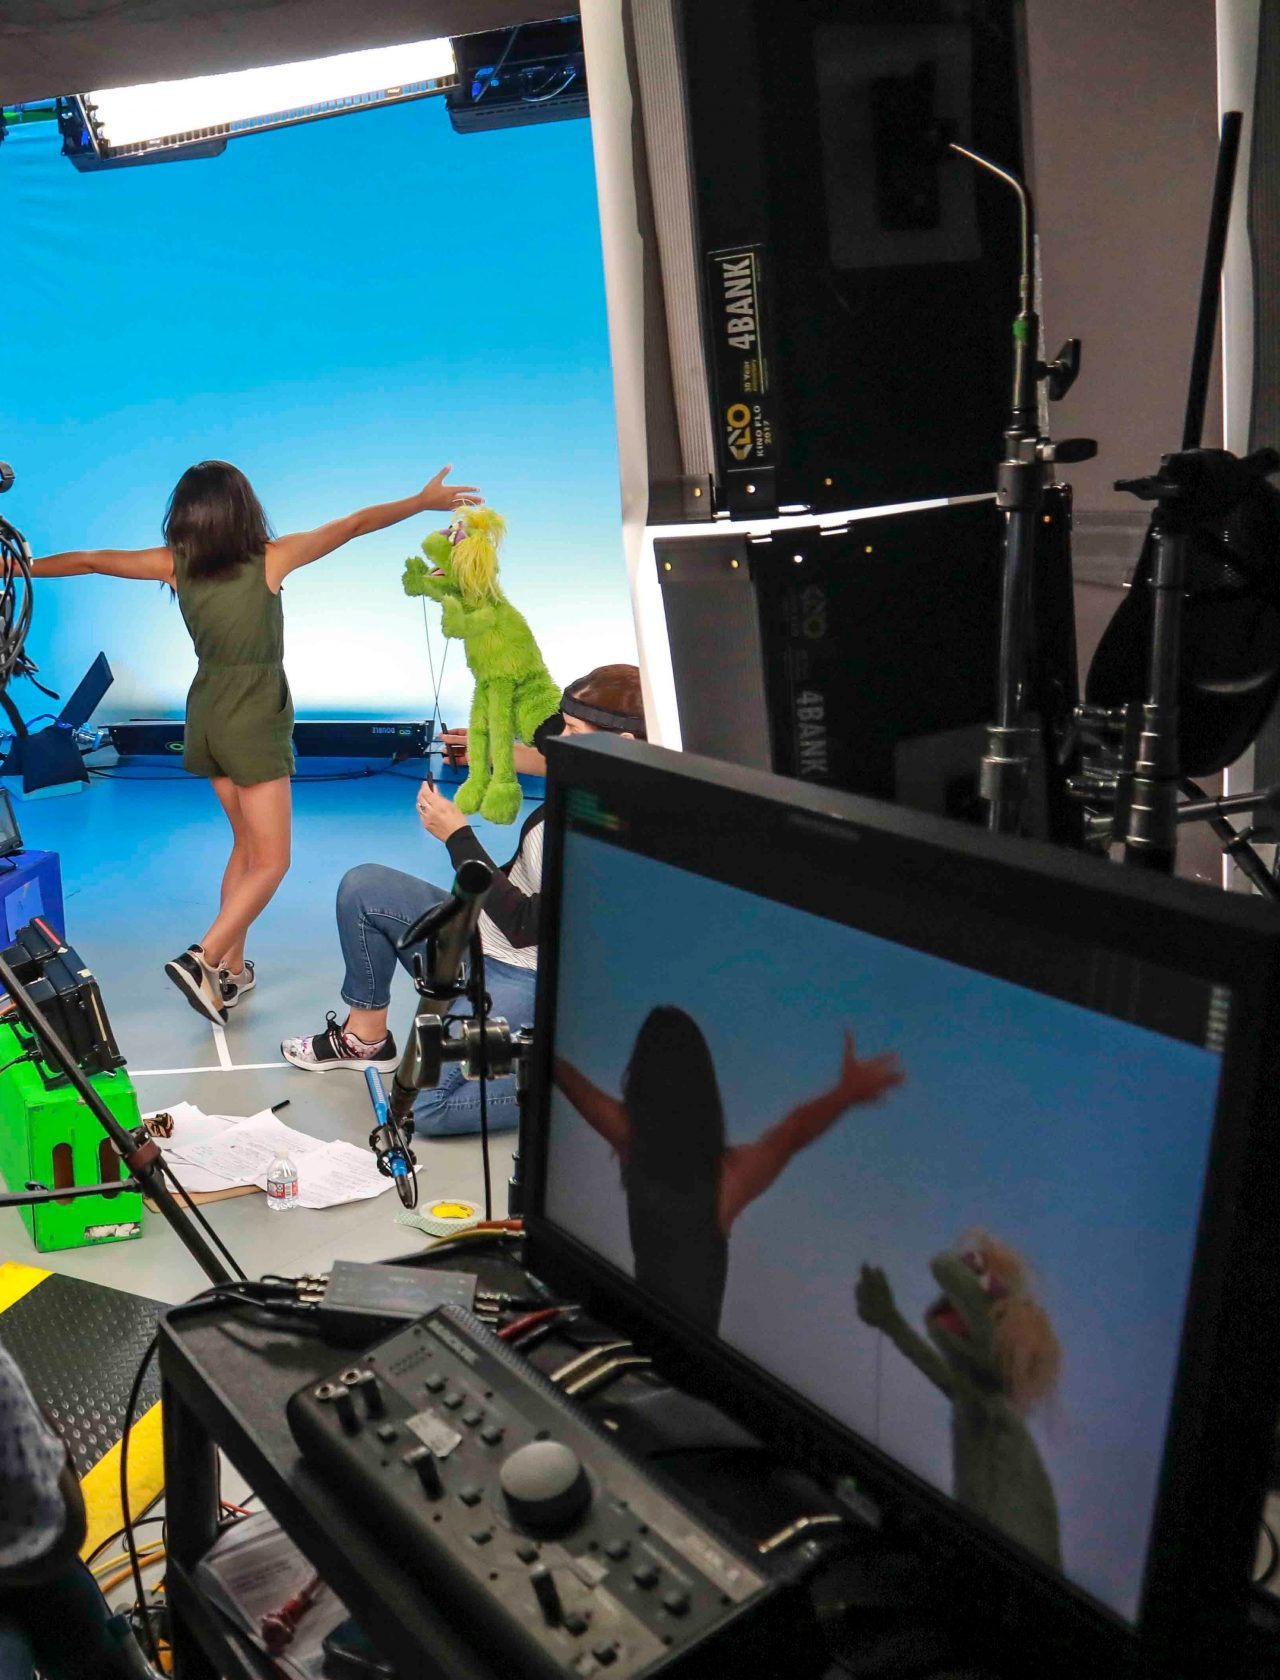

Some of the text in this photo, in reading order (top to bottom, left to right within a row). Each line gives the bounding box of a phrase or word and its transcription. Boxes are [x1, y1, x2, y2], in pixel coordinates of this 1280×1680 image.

[722, 258, 756, 350] 4BANK
[753, 405, 765, 457] KINO FLO
[763, 420, 772, 445] 2017
[796, 690, 829, 775] 4BANK
